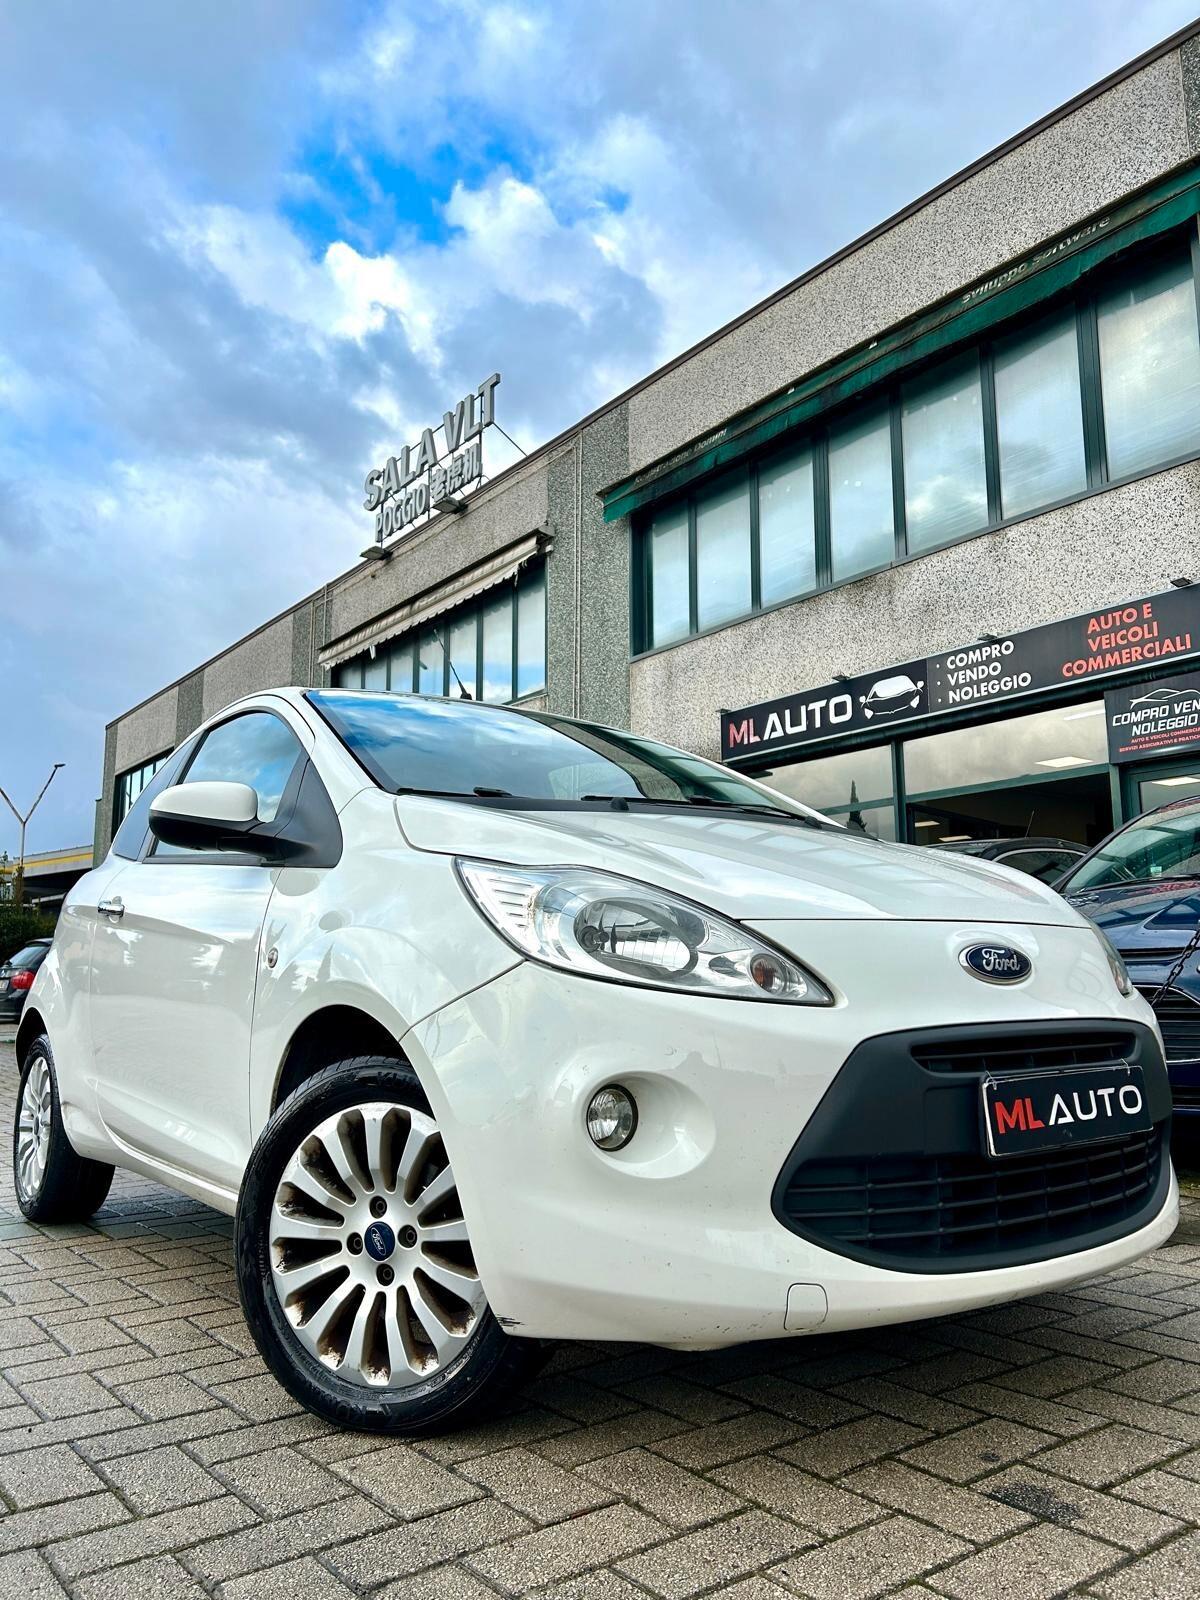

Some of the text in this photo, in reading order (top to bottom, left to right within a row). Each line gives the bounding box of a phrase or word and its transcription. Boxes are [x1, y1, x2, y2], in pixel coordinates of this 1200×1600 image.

[364, 373, 501, 511] SALA VLT
[375, 483, 430, 542] POGGIO
[1087, 603, 1152, 634] AUTO E
[1088, 621, 1158, 652] VEICOLI
[946, 640, 1015, 670] COMPRO
[1062, 633, 1192, 677] COMMERCIALI
[947, 662, 1002, 687] VENDO
[948, 672, 1032, 704] NOLEGGIO
[729, 694, 853, 748] ML AUTO
[1112, 705, 1170, 727] COMPRO
[1131, 713, 1198, 737] NOLEGGIO
[982, 948, 1021, 972] Ford
[994, 1084, 1143, 1135] ML AUTO
